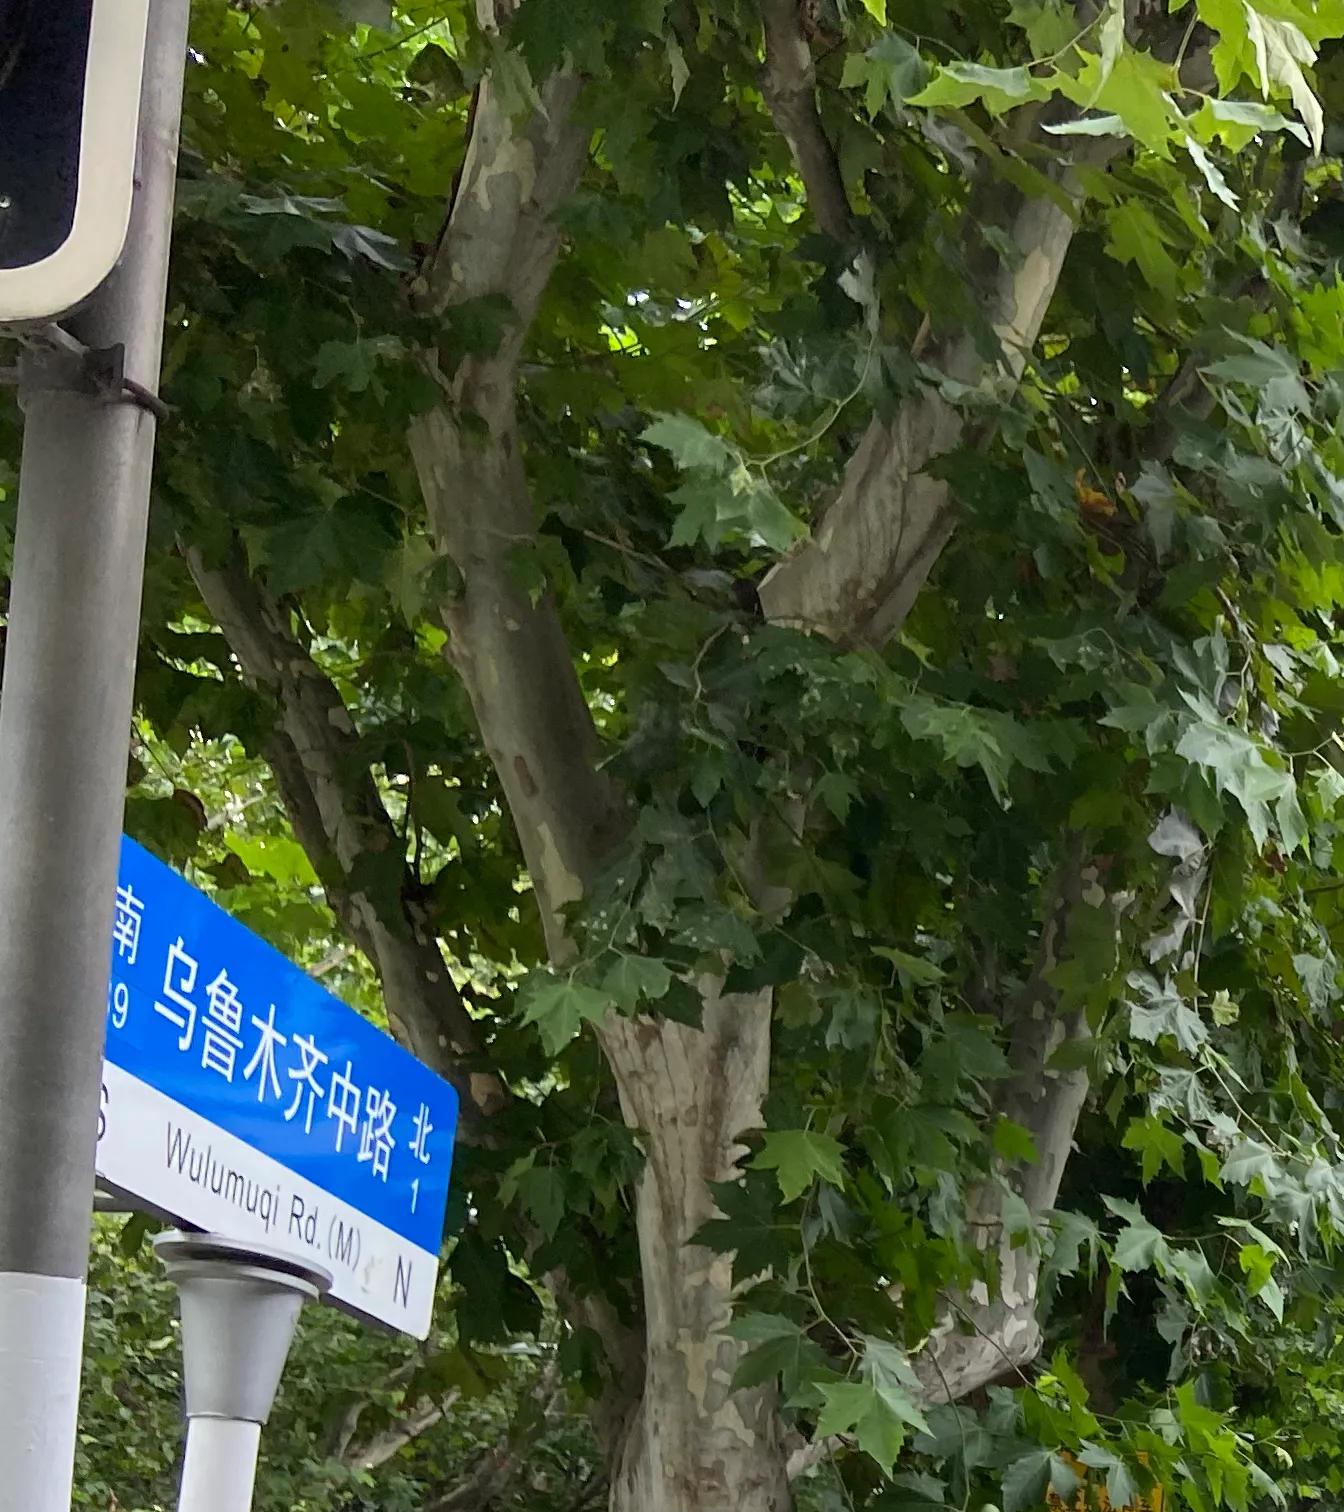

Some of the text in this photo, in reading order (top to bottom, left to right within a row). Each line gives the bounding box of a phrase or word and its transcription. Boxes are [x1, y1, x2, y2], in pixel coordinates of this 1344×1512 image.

[113, 884, 431, 1183] 南 乌鲁木齐中路 北
[166, 1121, 280, 1232] Wulumuqi
[289, 1195, 321, 1250] Rd.
[328, 1215, 361, 1270] (M)
[394, 1254, 413, 1309] N
[410, 1179, 419, 1213] 1
